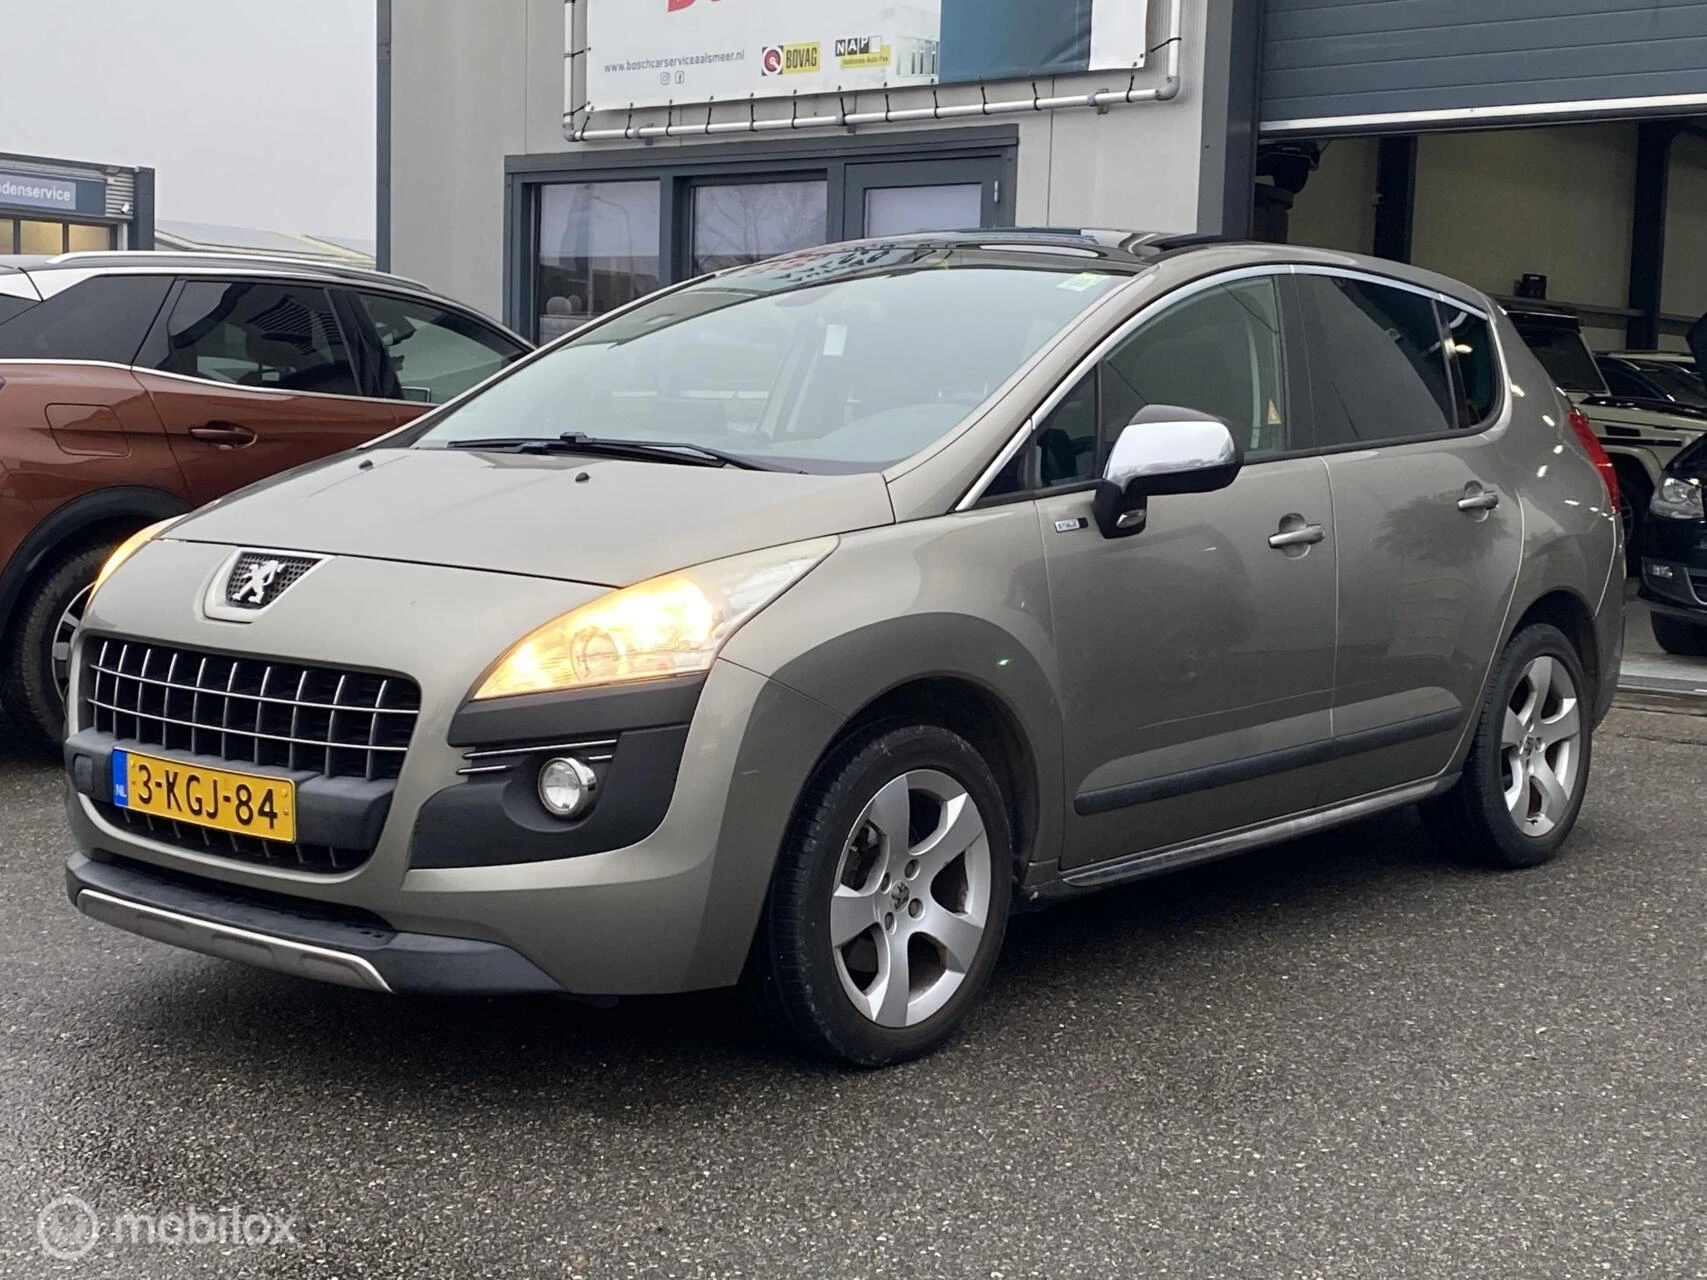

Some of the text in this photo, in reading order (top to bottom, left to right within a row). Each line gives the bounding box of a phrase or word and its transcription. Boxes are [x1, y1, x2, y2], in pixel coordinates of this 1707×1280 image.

[836, 37, 869, 56] NAP
[604, 49, 745, 73] www.boschcarserviceaalsmeer.nl
[786, 47, 818, 69] BOVAG
[0, 181, 71, 201] denservice
[115, 783, 127, 798] NL
[138, 764, 278, 830] 3-KGJ-84
